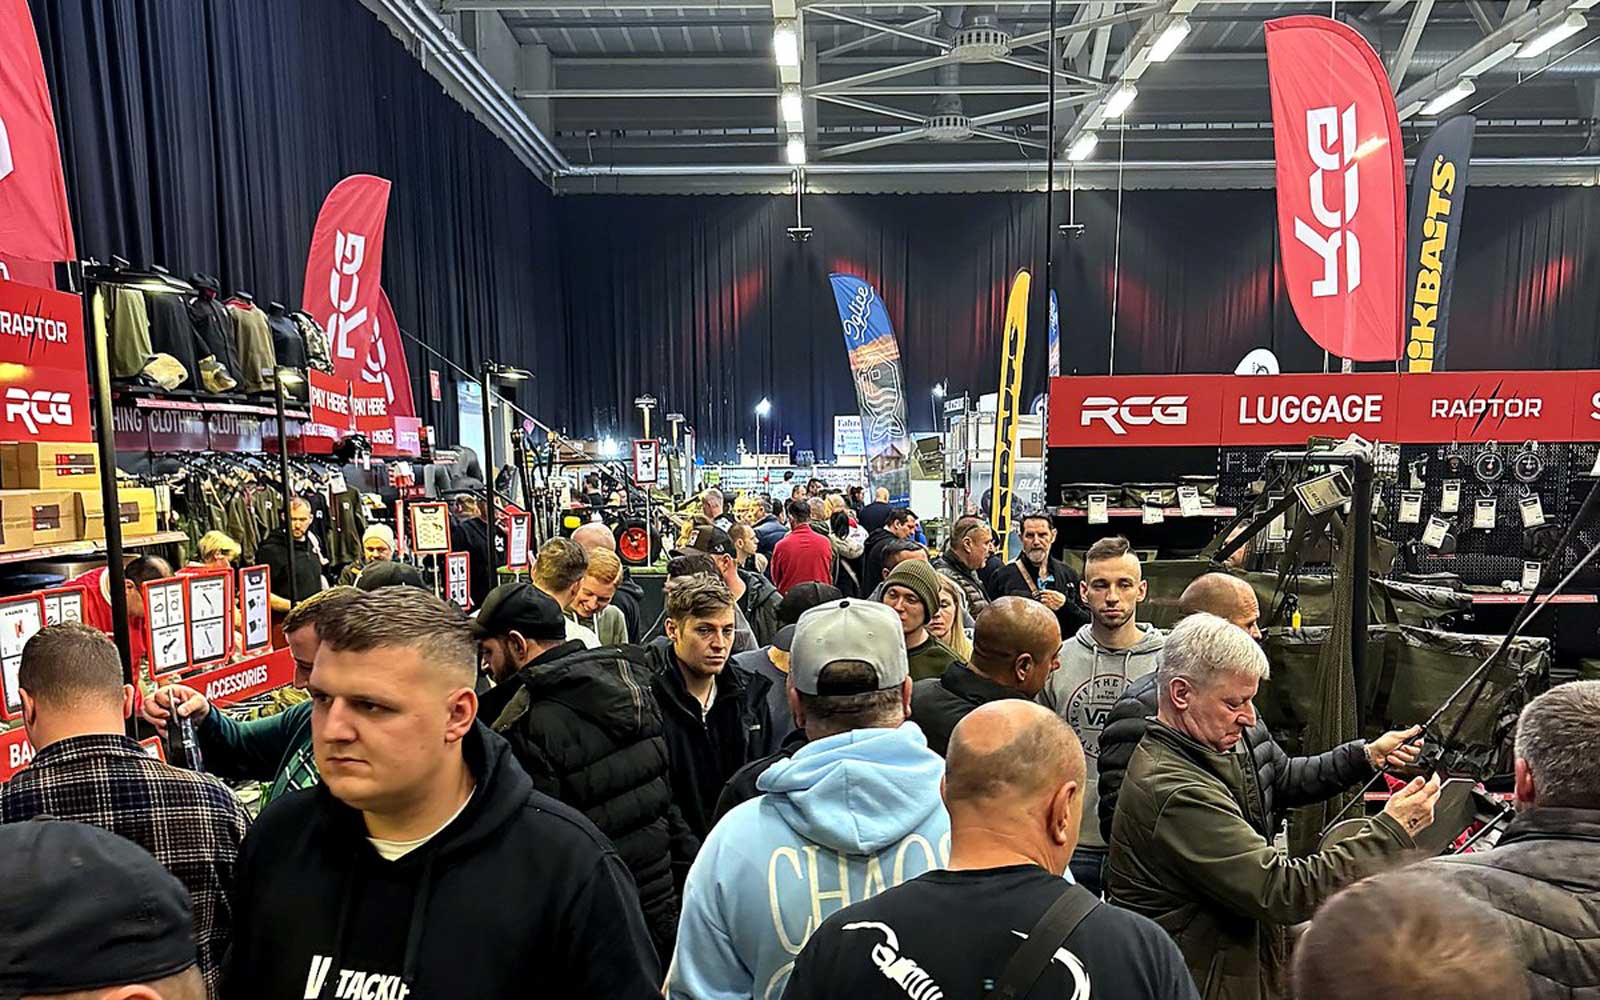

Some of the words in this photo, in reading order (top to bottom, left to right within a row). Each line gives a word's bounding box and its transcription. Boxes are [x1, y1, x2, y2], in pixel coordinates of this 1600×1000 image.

[327, 229, 368, 360] RCG
[0, 310, 68, 344] RAPTOR
[5, 387, 73, 434] RCG
[311, 386, 326, 408] PAY
[326, 391, 349, 415] HERE
[354, 399, 367, 416] PAY
[367, 397, 387, 416] HERE
[1080, 395, 1189, 435] RCG
[1238, 393, 1383, 426] LUGGAGE
[1430, 397, 1543, 419] RAPTOR
[151, 408, 204, 434] CLOTHING
[205, 664, 268, 701] ACCESSORIES
